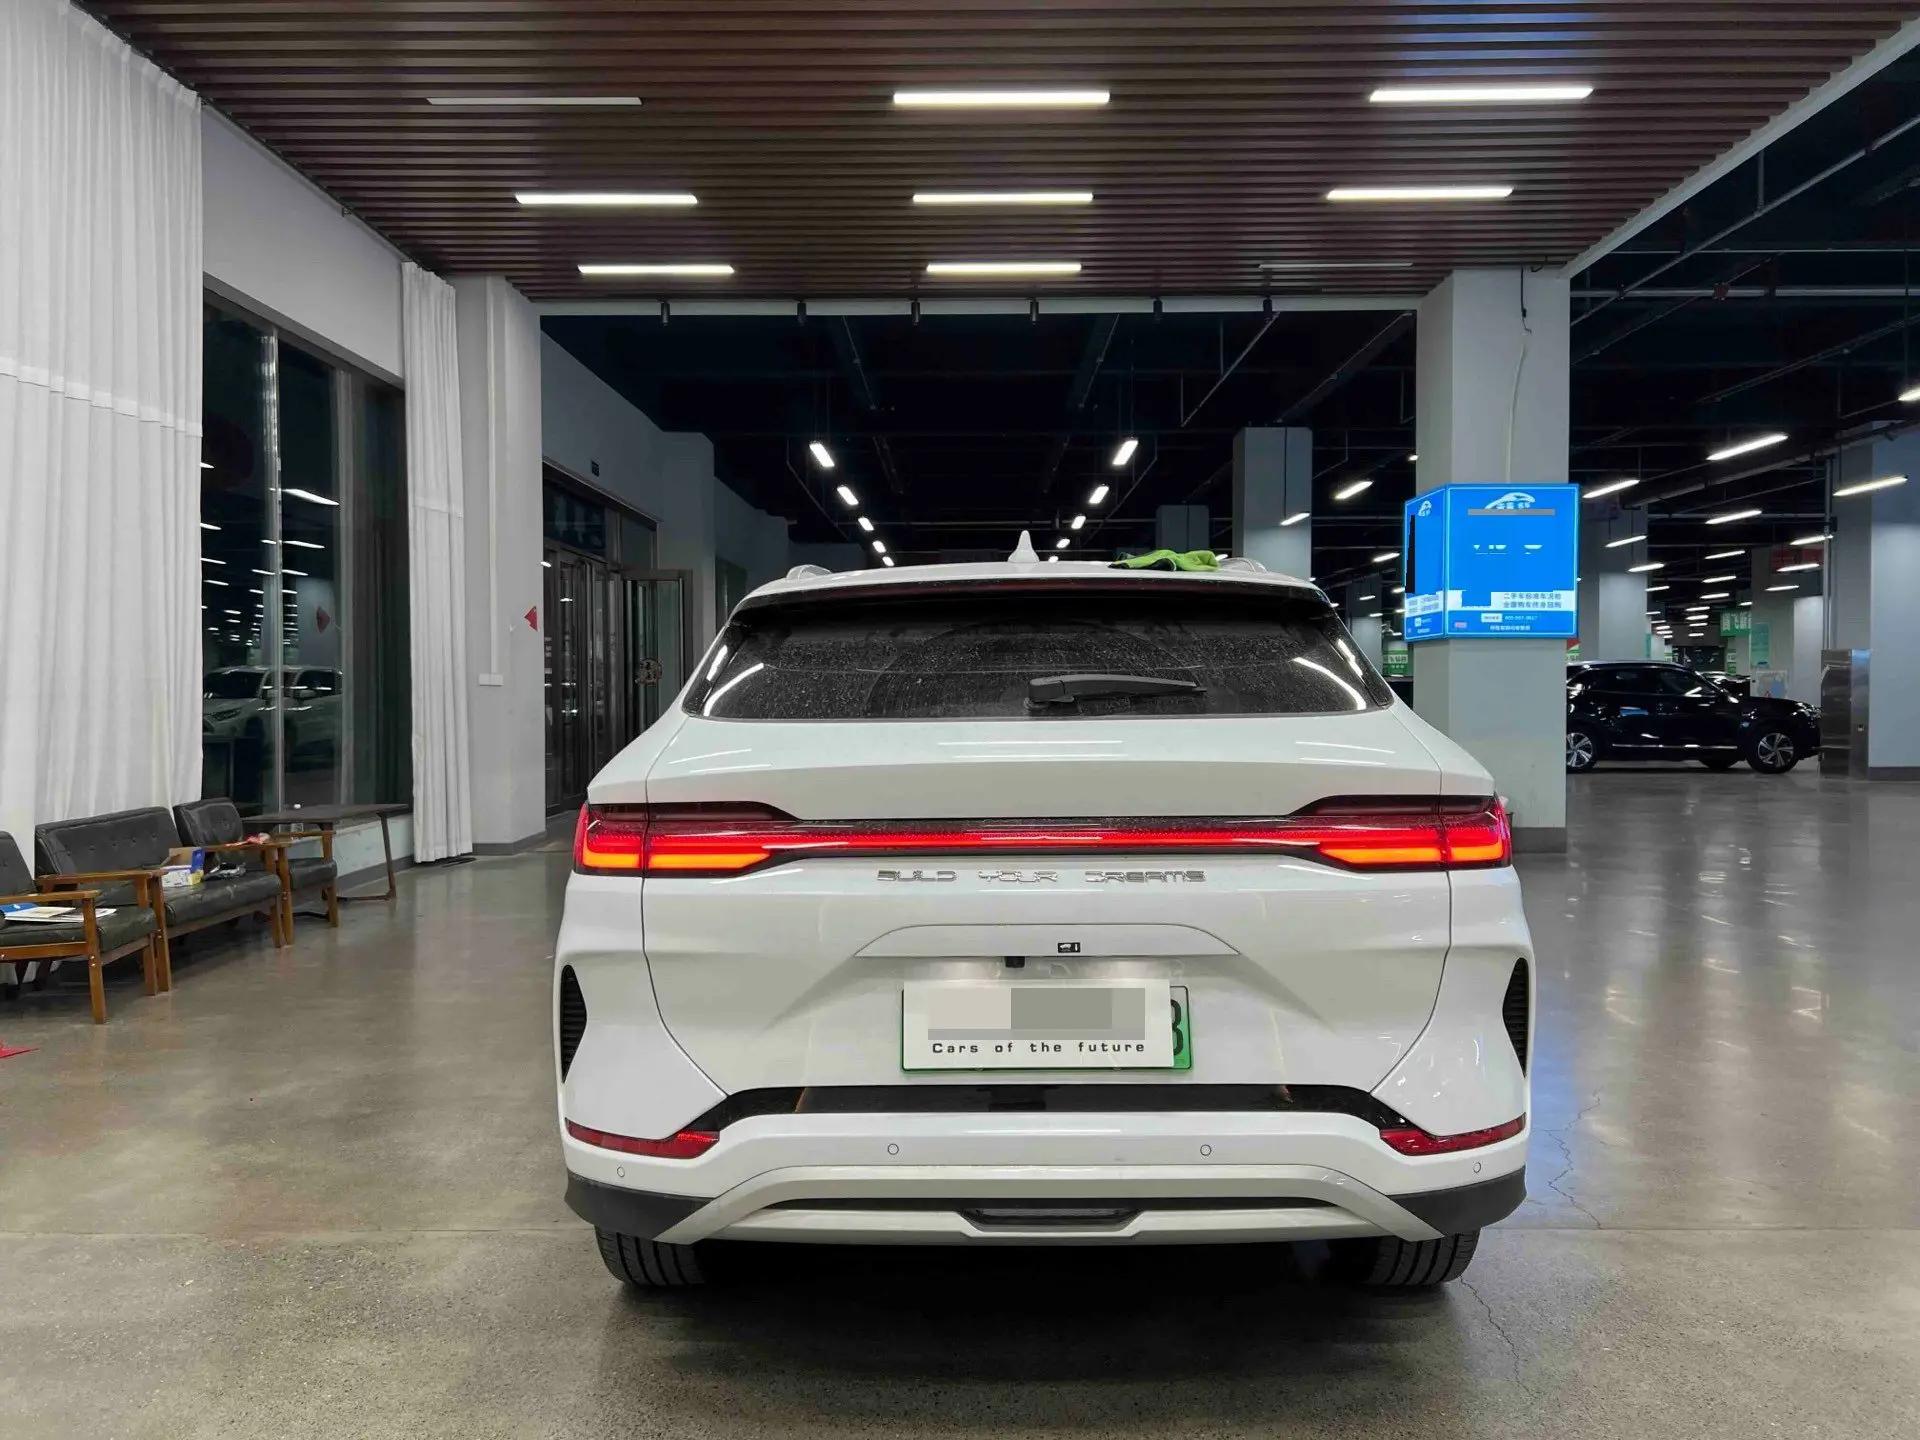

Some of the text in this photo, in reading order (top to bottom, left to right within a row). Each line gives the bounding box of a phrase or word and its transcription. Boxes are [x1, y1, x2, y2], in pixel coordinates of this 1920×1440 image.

[978, 870, 1058, 882] YOUR
[1085, 870, 1206, 882] DREAMS
[932, 1041, 1146, 1054] Cars of the future
